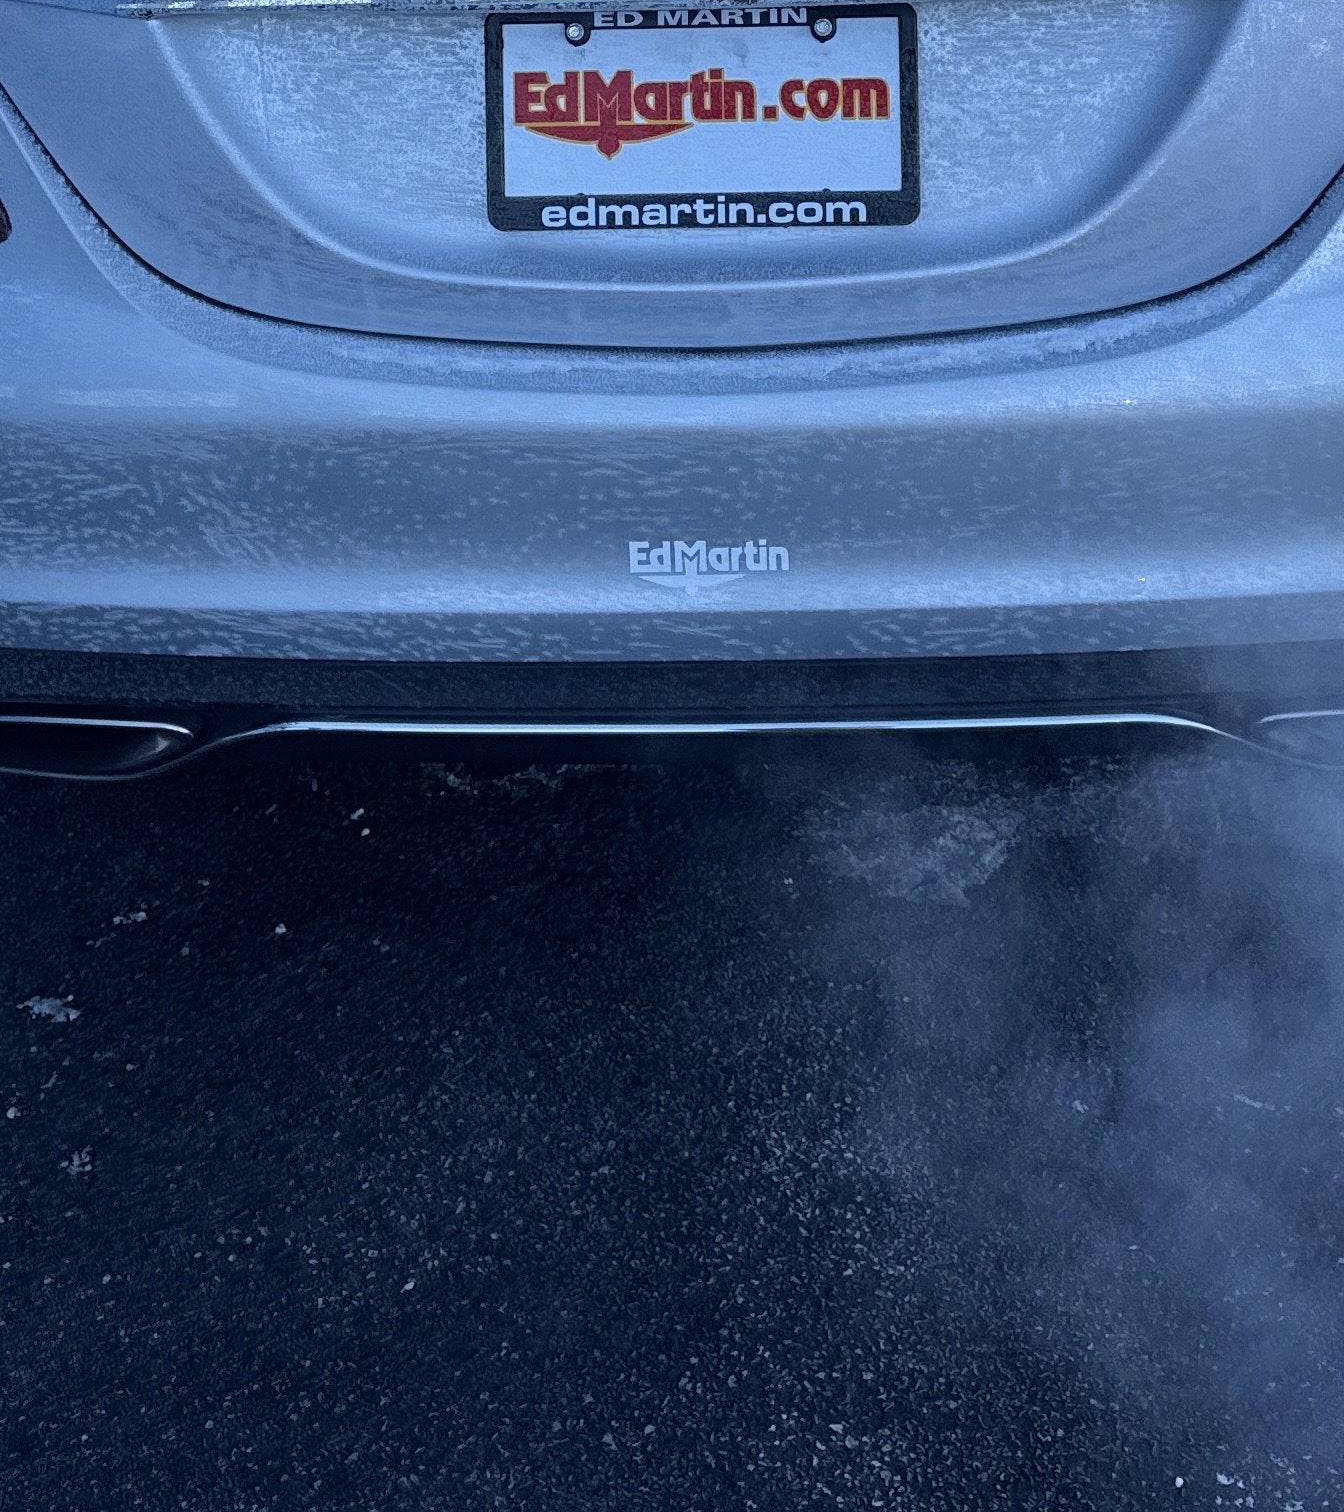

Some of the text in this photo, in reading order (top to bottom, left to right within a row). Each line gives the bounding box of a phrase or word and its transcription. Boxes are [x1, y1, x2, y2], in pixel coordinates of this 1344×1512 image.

[593, 7, 808, 27] ED MARTIN
[512, 67, 891, 130] EdMartin.com
[540, 195, 868, 228] edmartin.com
[628, 538, 790, 575] EdMartin
